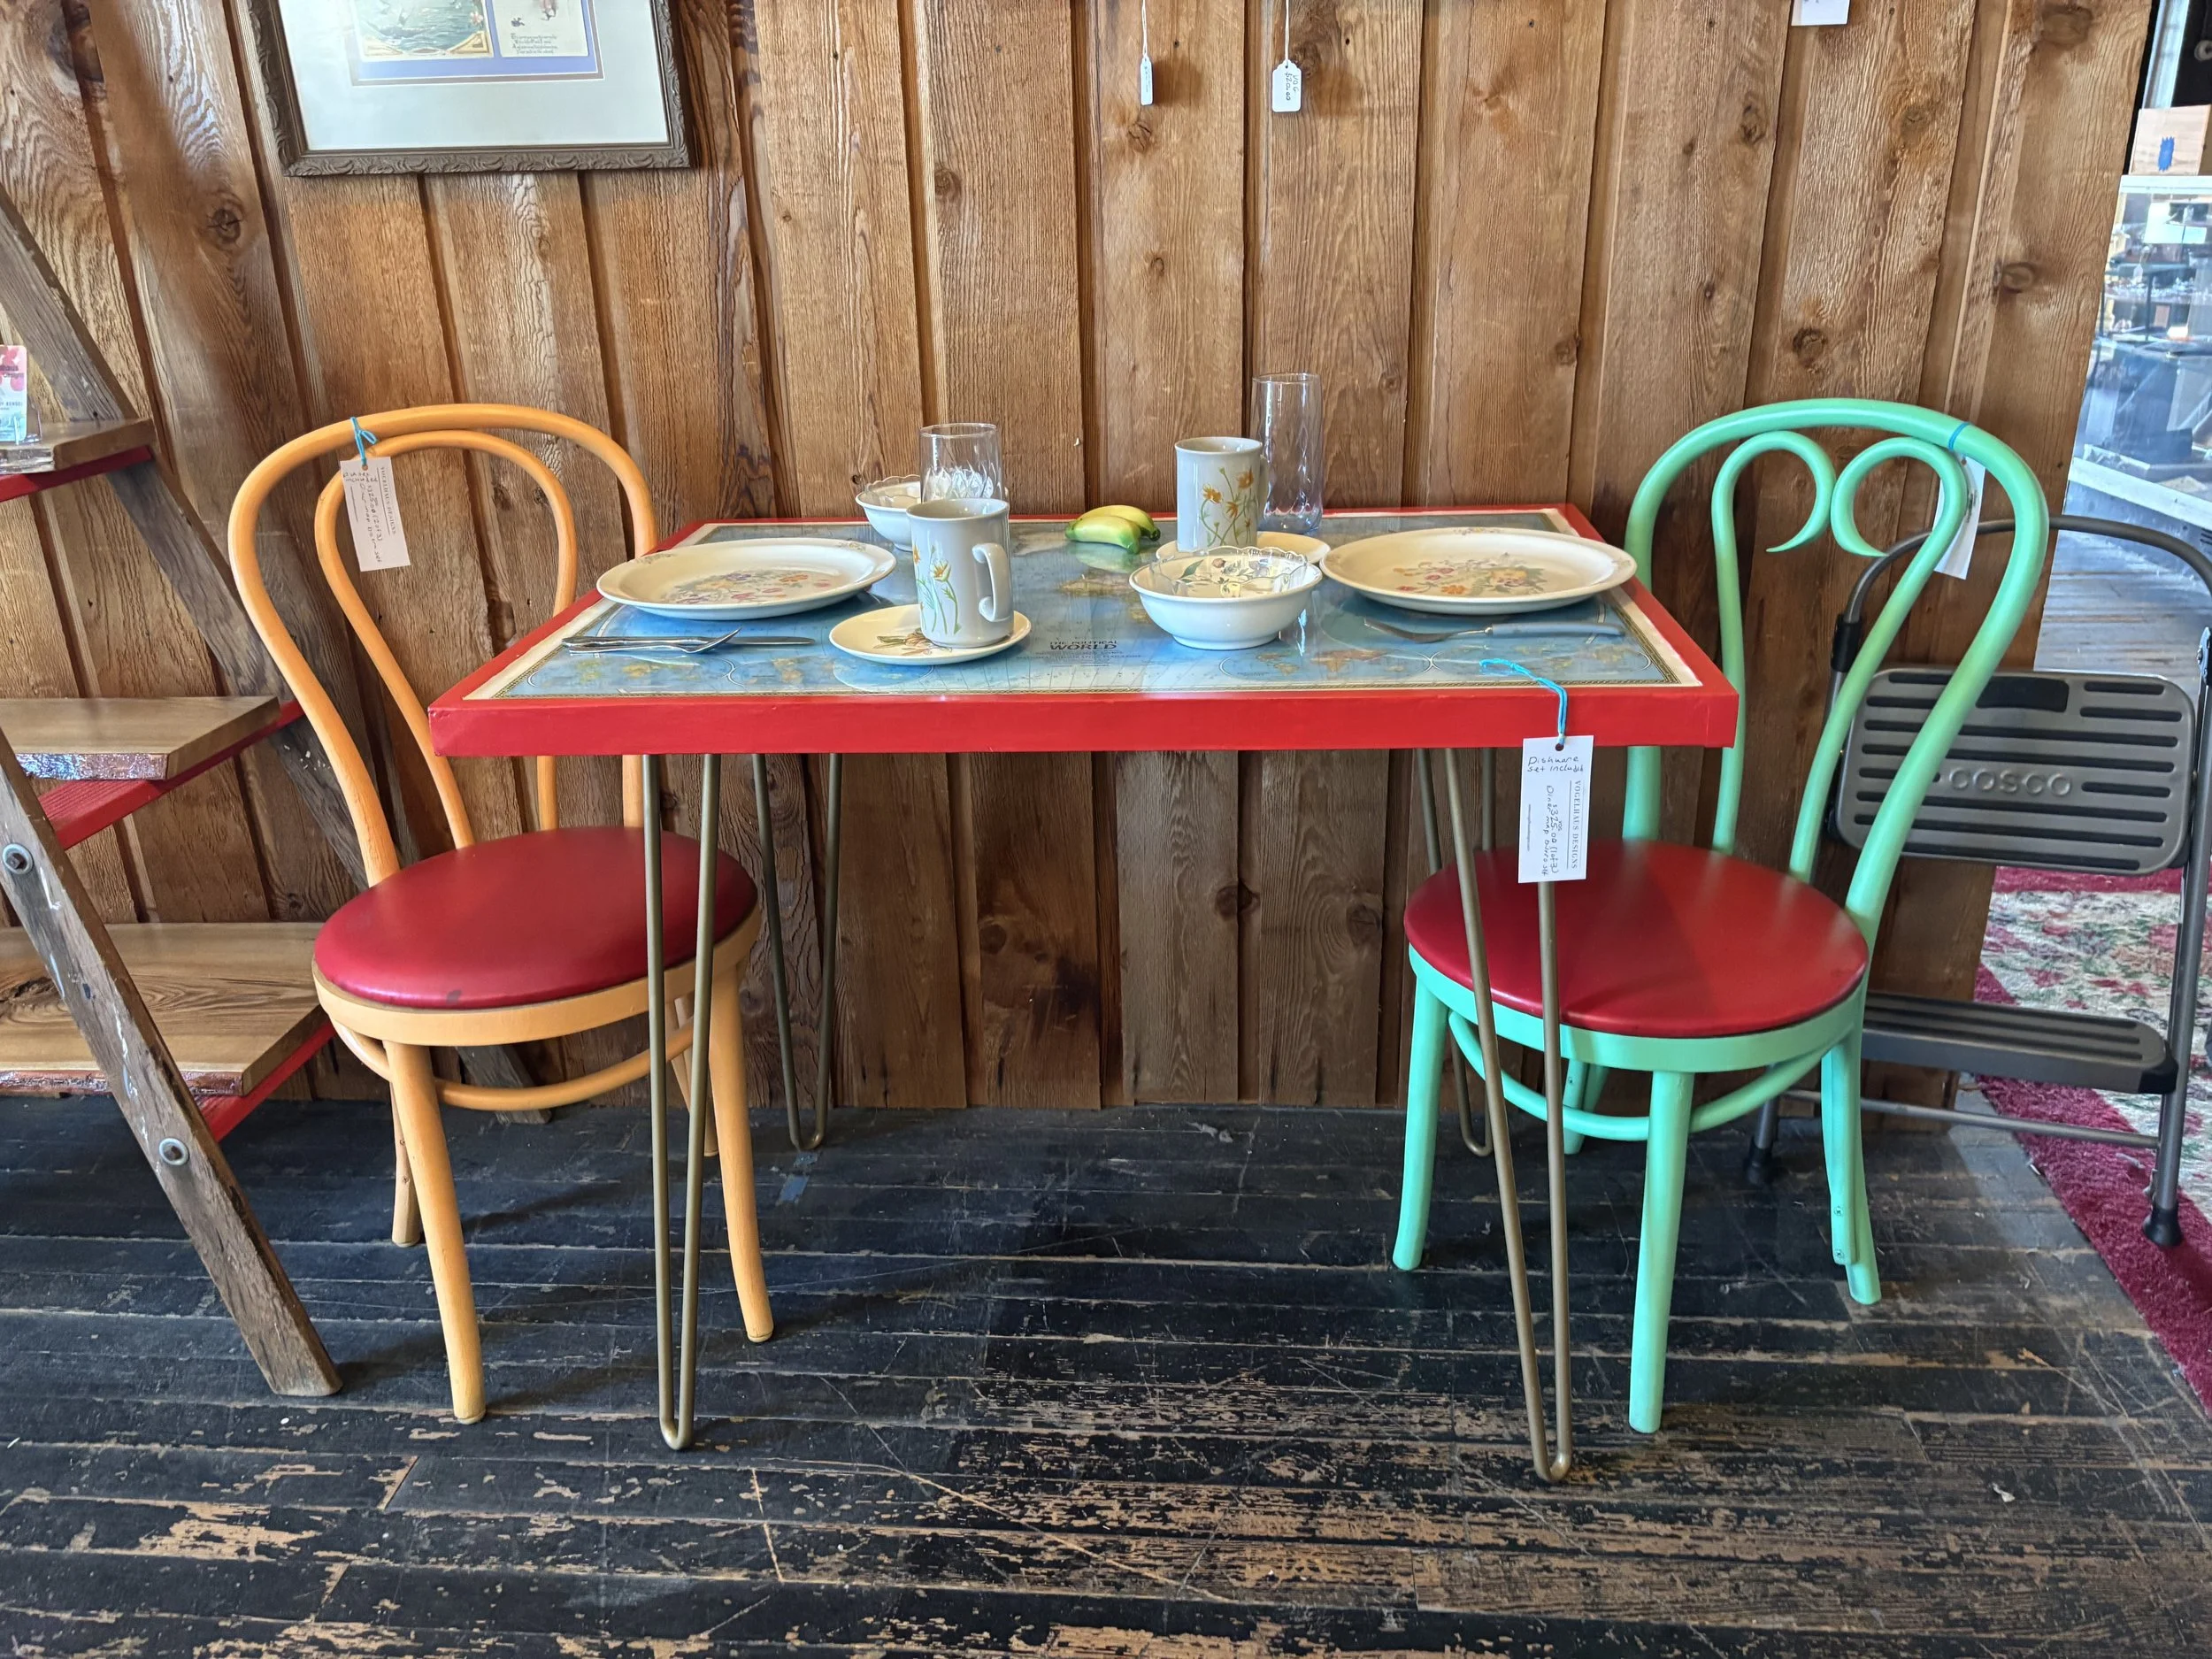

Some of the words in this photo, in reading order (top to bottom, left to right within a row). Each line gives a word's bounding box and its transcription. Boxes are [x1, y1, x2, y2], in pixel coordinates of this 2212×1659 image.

[1948, 766, 2073, 797] COSCO
[1572, 780, 1582, 831] VOGELHAUS
[1571, 833, 1579, 869] DESIGNS
